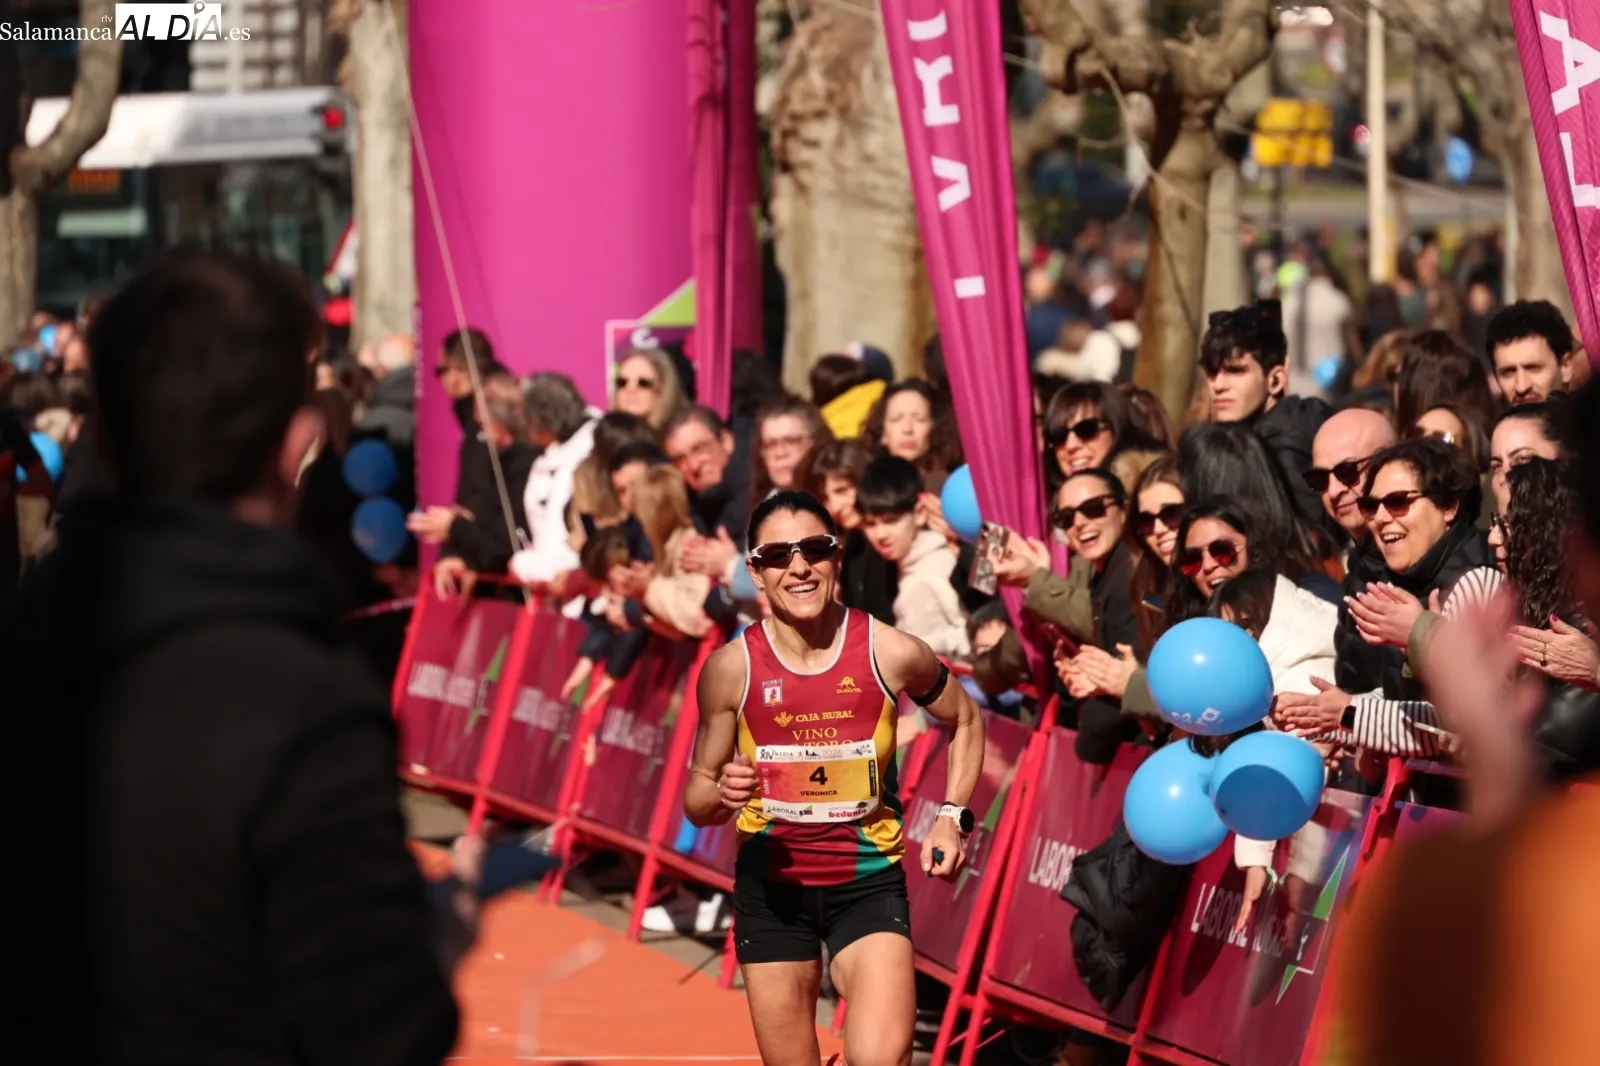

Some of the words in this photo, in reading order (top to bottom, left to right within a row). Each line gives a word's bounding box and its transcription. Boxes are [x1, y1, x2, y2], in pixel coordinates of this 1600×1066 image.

[795, 713, 820, 723] CAJA
[822, 710, 855, 720] RURAL
[792, 726, 838, 741] VINO
[809, 766, 828, 785] 4
